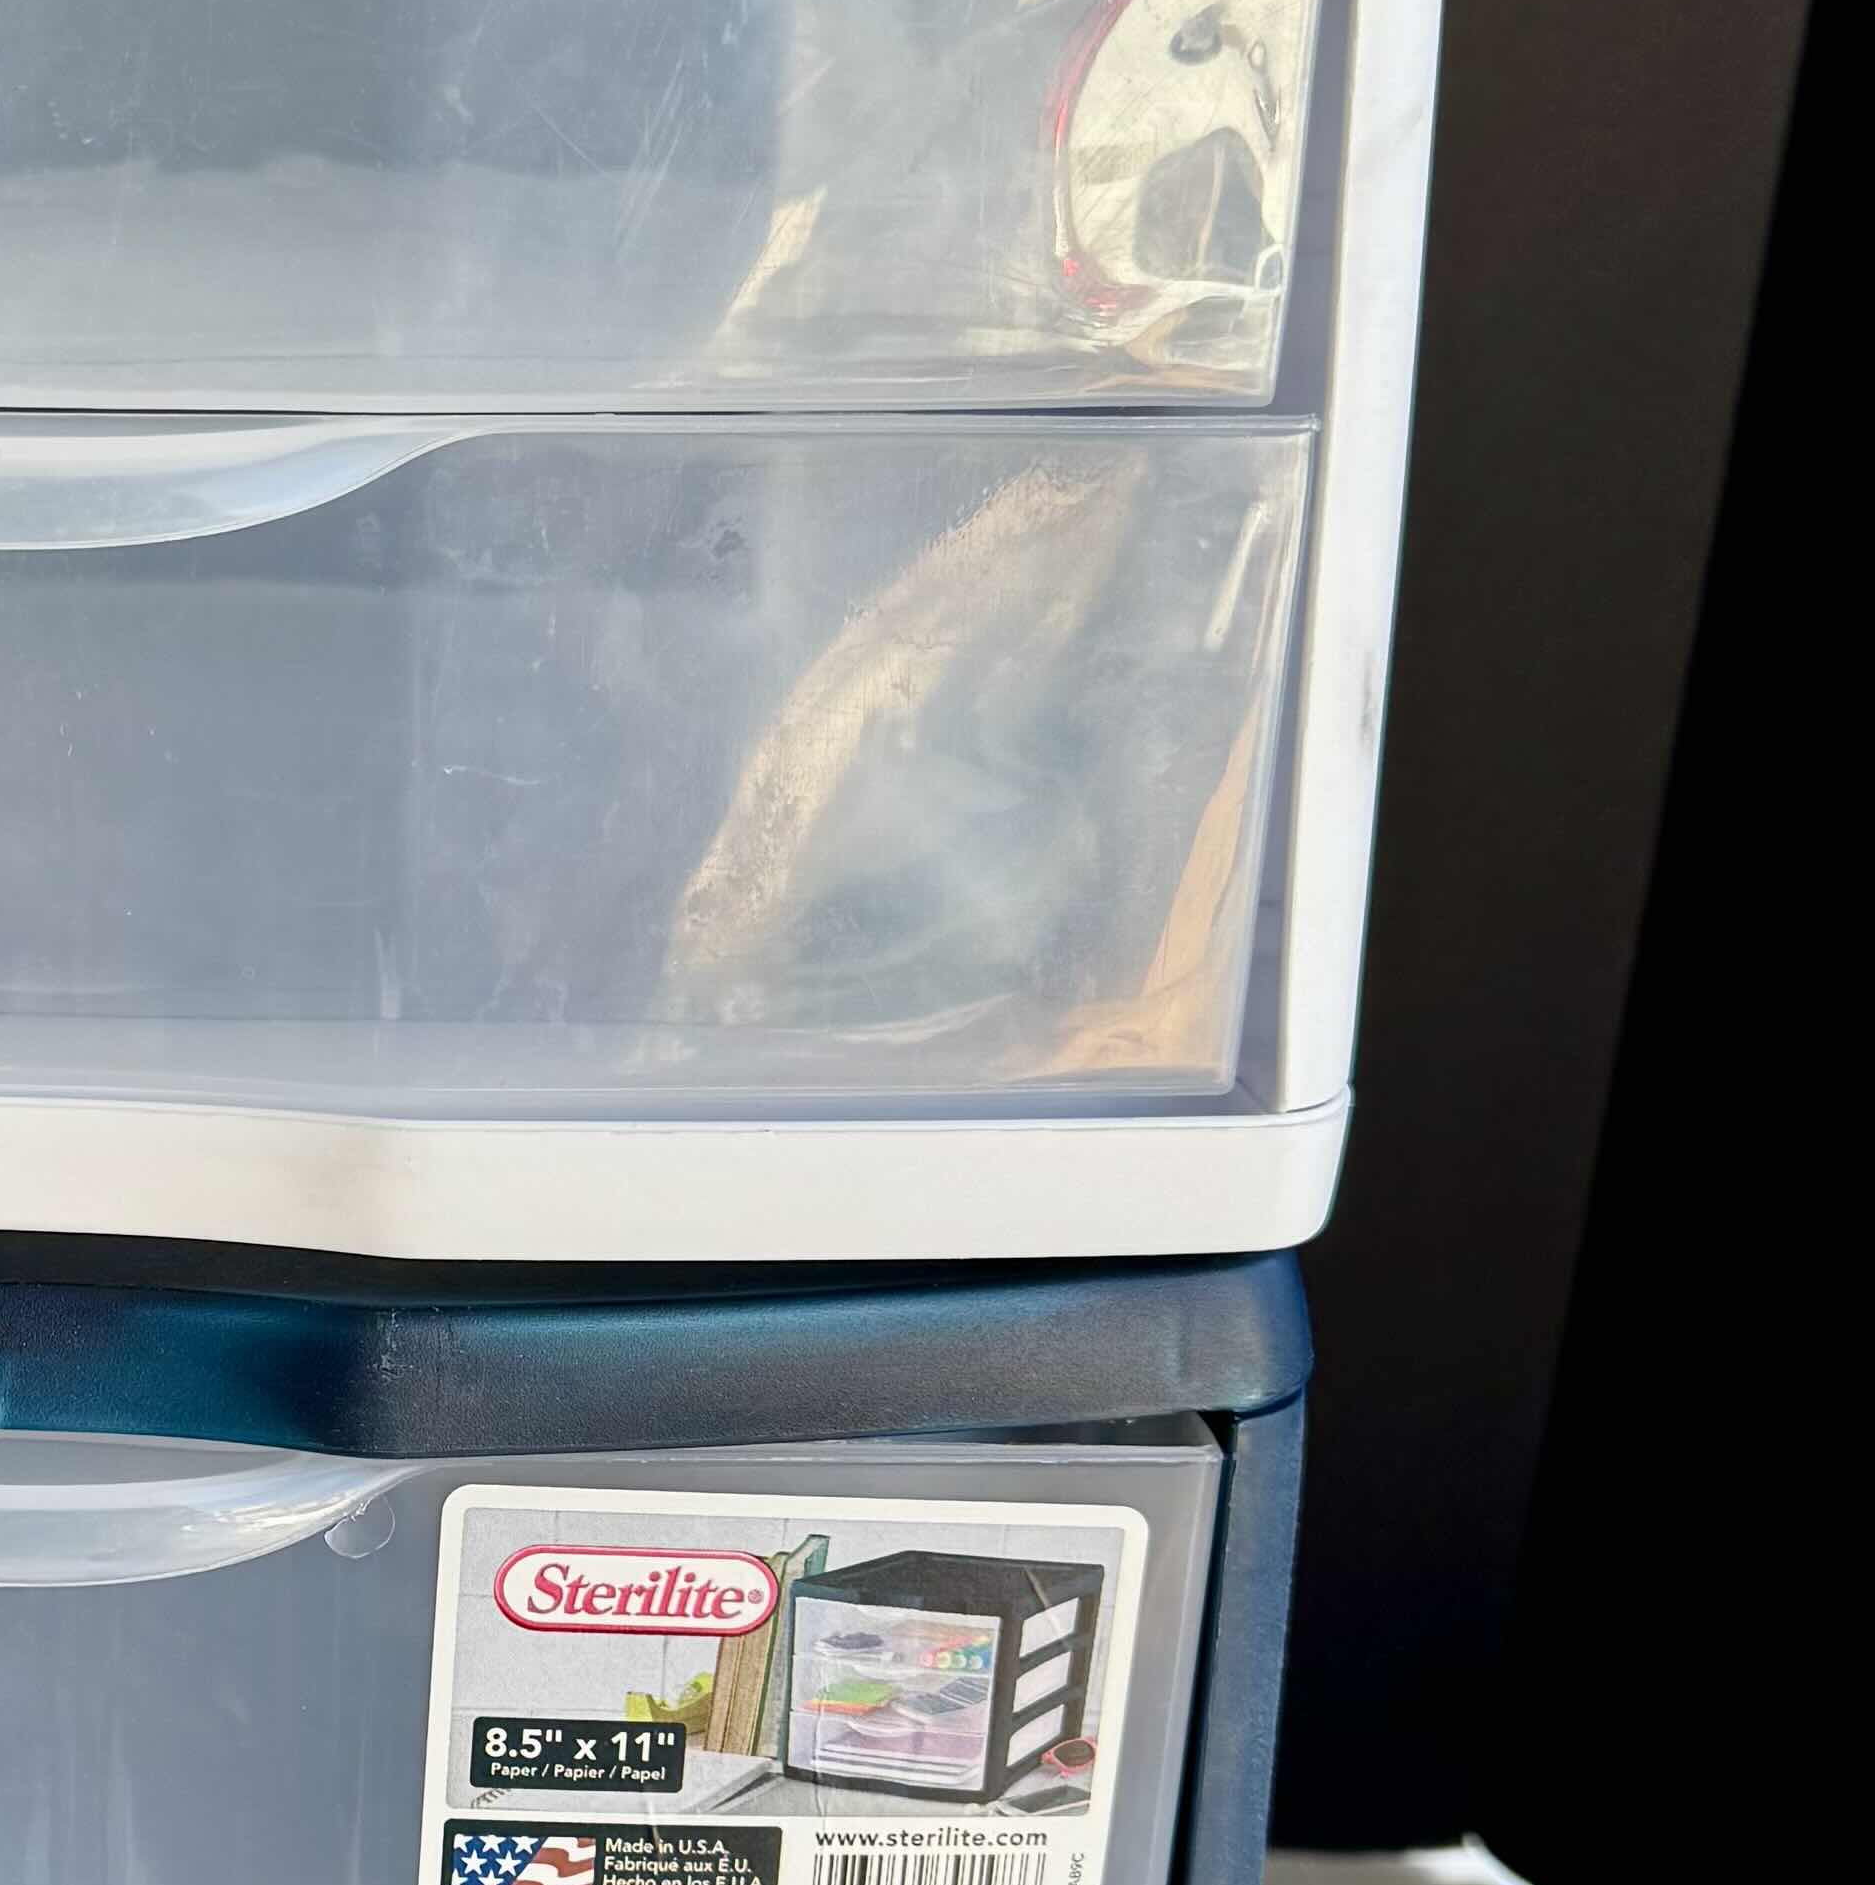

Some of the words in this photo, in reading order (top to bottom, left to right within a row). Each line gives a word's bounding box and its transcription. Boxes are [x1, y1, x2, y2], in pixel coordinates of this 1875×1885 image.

[484, 1728, 562, 1759] 8.5"
[574, 1738, 596, 1760] x
[611, 1732, 675, 1762] 11"
[491, 1763, 537, 1780] Paper
[541, 1764, 549, 1778] /
[554, 1765, 605, 1781] Papier
[609, 1765, 617, 1780] /
[622, 1766, 665, 1782] Papel
[605, 1838, 654, 1854] Made
[658, 1839, 673, 1854] in
[678, 1840, 729, 1855] U.S.A.
[815, 1827, 1048, 1847] www.sterilite.com
[604, 1856, 678, 1875] Fabriqué
[683, 1861, 713, 1873] aux
